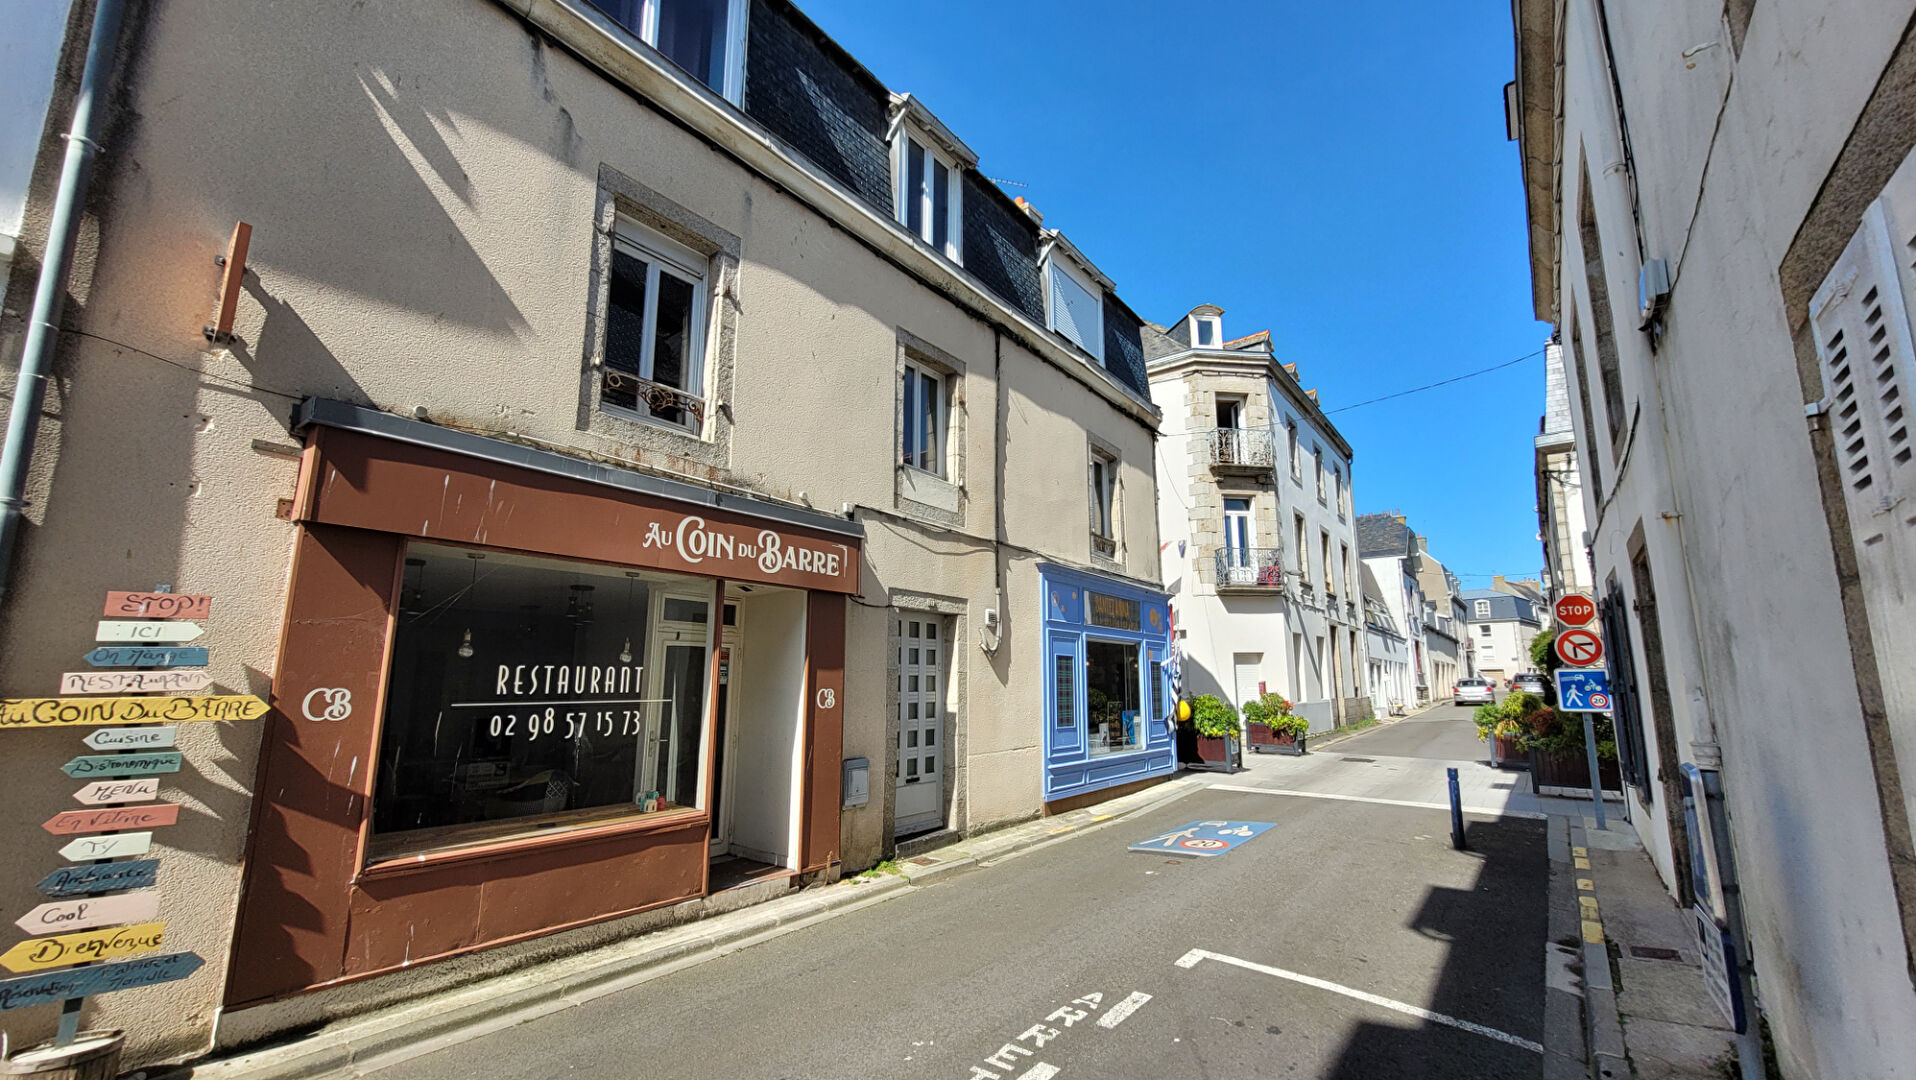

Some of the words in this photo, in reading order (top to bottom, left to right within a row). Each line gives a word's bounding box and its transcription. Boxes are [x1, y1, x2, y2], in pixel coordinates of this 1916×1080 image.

[643, 522, 672, 549] AU
[676, 516, 734, 563] COIN
[738, 543, 757, 559] DU
[758, 530, 840, 577] BARRE
[1559, 605, 1592, 616] STOP
[131, 626, 162, 638] ICI
[93, 650, 118, 664] On
[496, 665, 644, 695] RESTAURANT
[32, 700, 117, 724] COIN
[162, 697, 260, 721] BARRE
[302, 687, 352, 722] CB
[1593, 697, 1604, 705] 20
[489, 714, 517, 737] 02
[528, 707, 555, 741] 98
[564, 712, 587, 739] 57
[596, 711, 613, 737] 15
[622, 710, 641, 736] 73
[94, 732, 161, 745] Cuisine
[56, 814, 82, 830] En
[90, 810, 157, 827] Vitrine
[41, 903, 88, 924] Cool
[29, 928, 163, 963] Bienvenue
